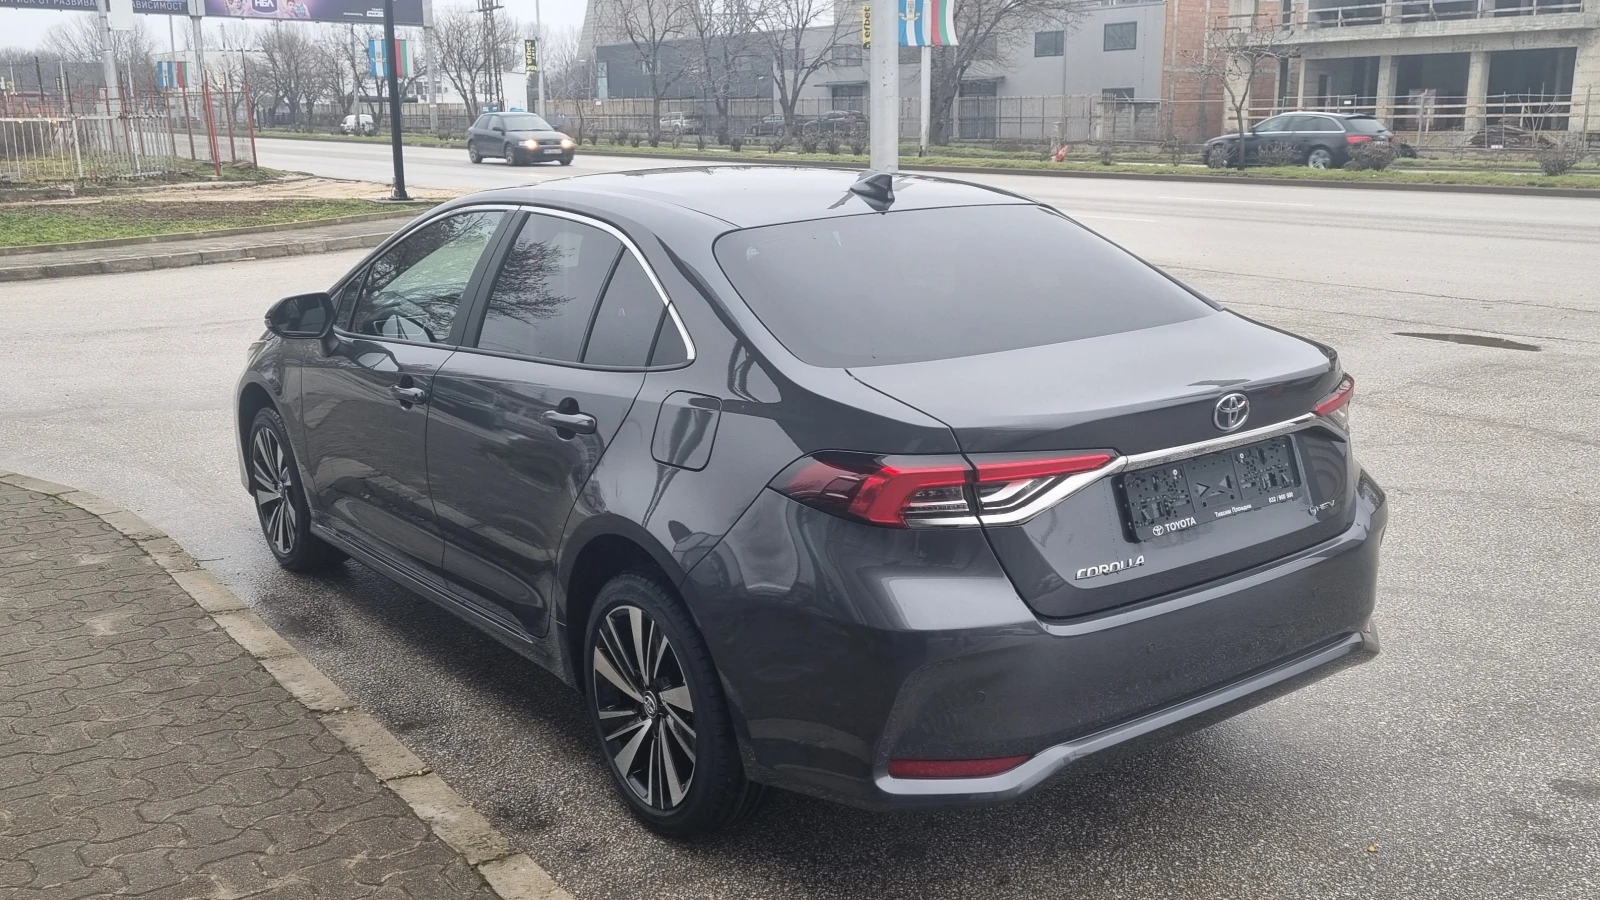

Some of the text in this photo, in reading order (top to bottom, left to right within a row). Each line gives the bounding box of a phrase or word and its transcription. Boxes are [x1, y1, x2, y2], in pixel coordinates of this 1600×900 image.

[863, 6, 871, 38] efbet
[1165, 517, 1197, 532] TOYOTA
[1075, 555, 1145, 581] COROLLA
